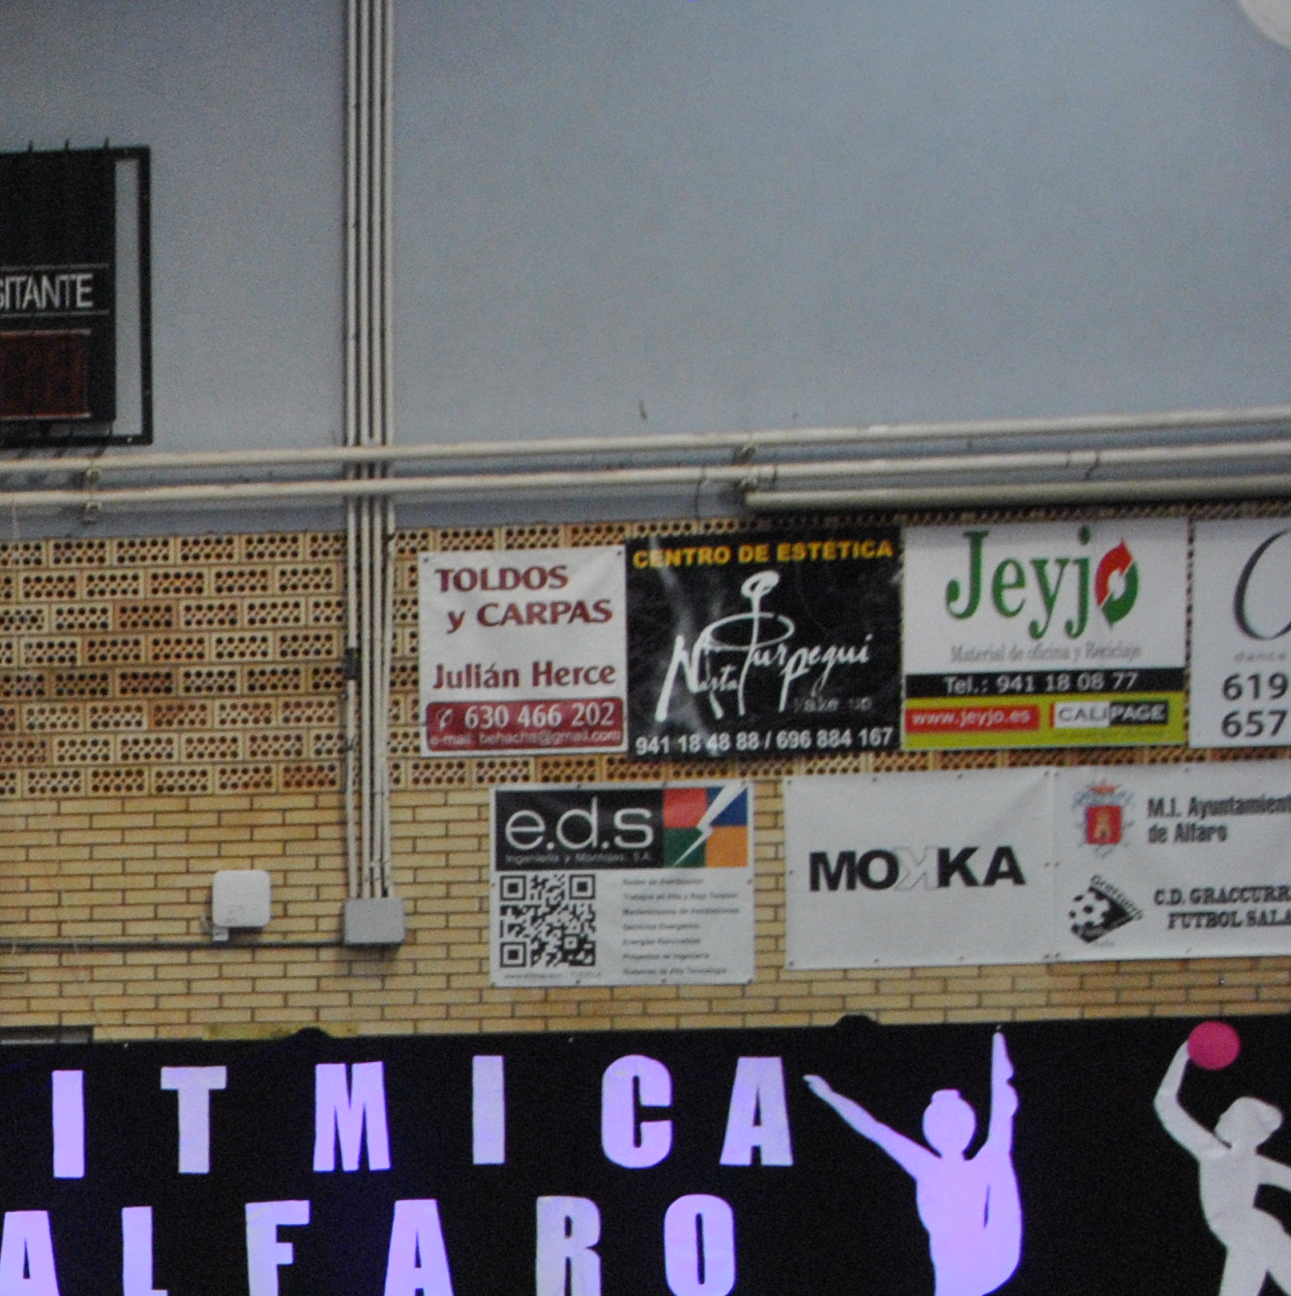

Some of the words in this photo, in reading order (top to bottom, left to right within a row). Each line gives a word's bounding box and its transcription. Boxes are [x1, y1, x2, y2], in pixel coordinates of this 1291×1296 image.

[633, 545, 732, 569] CENTRO
[738, 544, 769, 563] DE
[435, 564, 569, 592] TOLDOS
[447, 608, 465, 633] y
[477, 600, 613, 627] CARPAS
[433, 663, 520, 690] Julián
[531, 659, 616, 687] Herce
[996, 674, 1036, 694] 941
[1046, 673, 1071, 692] 18
[1077, 672, 1104, 691] 08
[1112, 671, 1139, 690] 77
[1222, 671, 1289, 700] 619
[464, 704, 510, 729] 630
[517, 703, 563, 728] 466
[571, 702, 616, 727] 202
[1221, 709, 1288, 738] 657
[635, 736, 671, 756] 941
[677, 734, 702, 753] 18
[736, 731, 760, 751] 88
[776, 729, 812, 750] 696
[816, 728, 853, 748] 884
[858, 726, 894, 747] 167
[505, 796, 654, 850] e.d.s
[1148, 823, 1168, 844] de
[1174, 822, 1228, 844] Alfaro
